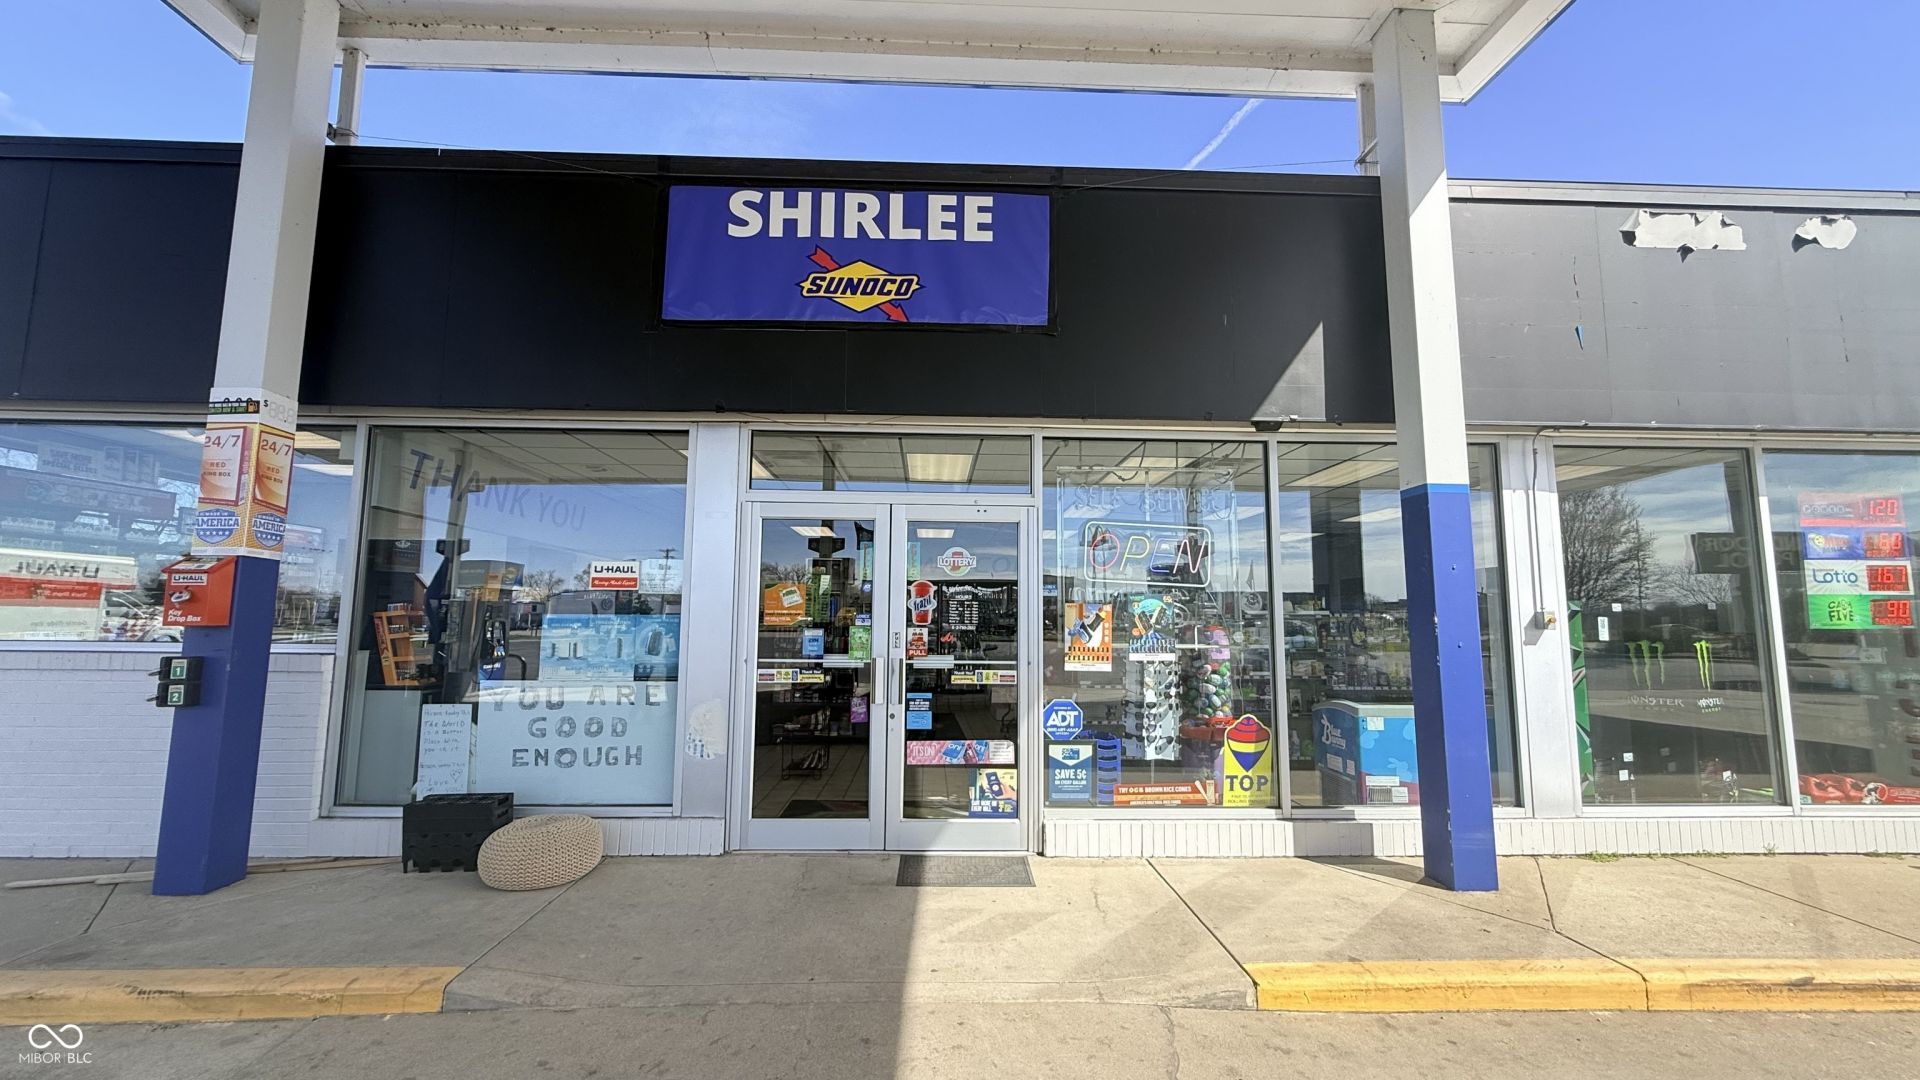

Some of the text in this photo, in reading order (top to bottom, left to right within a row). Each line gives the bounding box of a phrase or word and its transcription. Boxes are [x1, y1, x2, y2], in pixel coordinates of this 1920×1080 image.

[728, 190, 994, 242] SHIRLEE
[805, 275, 917, 298] SUNOCO
[204, 434, 241, 449] 24/7
[261, 439, 292, 456] 24/7
[410, 449, 587, 532] THANK YOU
[1869, 499, 1898, 516] 120
[1089, 532, 1206, 574] OPEN
[594, 565, 637, 574] U-HAUL
[940, 557, 975, 567] LOTTERY
[1812, 568, 1859, 584] Lotto
[168, 608, 183, 617] Key
[1828, 610, 1854, 622] FIVE
[1887, 600, 1910, 618] 90
[167, 614, 186, 623] Drop
[175, 667, 181, 676] 1
[172, 693, 179, 702] 2
[488, 684, 661, 711] YOU ARE
[527, 716, 629, 738] GOOD
[1046, 711, 1079, 727] ADT
[511, 745, 643, 769] ENOUGH
[913, 745, 924, 759] IT'S
[1055, 768, 1087, 780] SAVE 5¢
[1225, 774, 1269, 792] TOP
